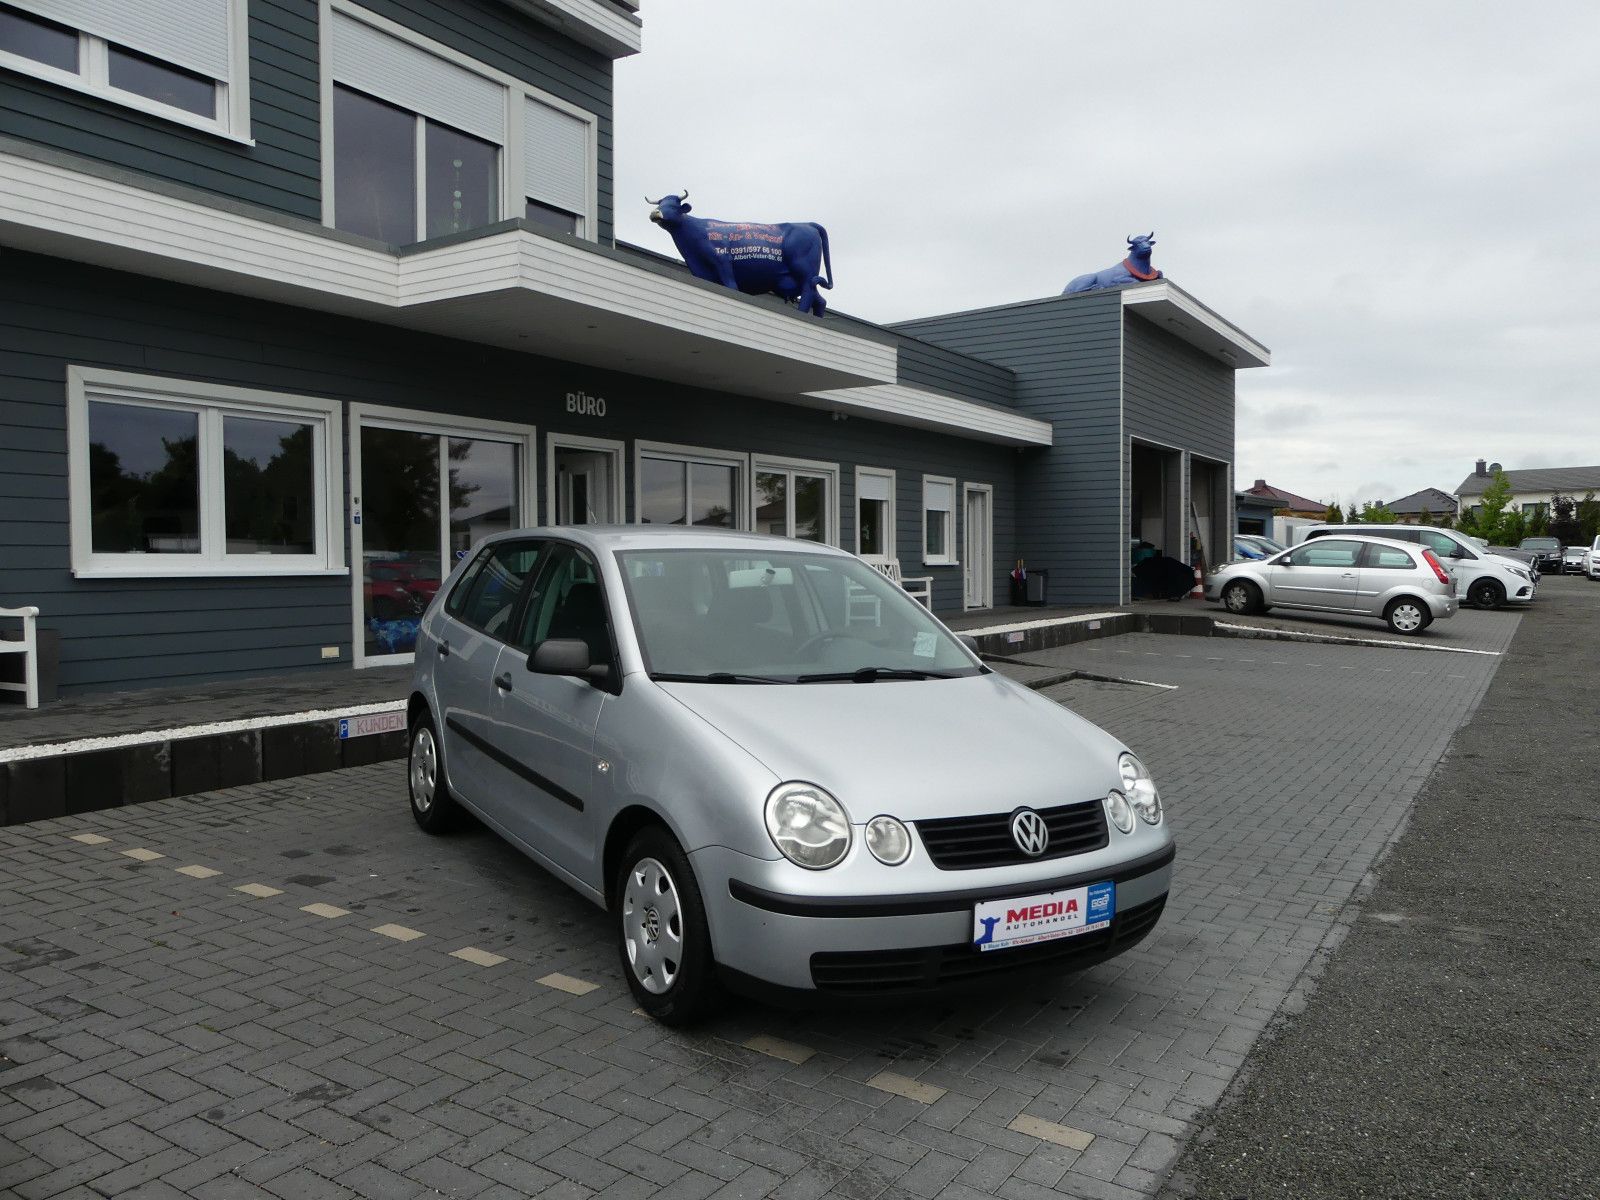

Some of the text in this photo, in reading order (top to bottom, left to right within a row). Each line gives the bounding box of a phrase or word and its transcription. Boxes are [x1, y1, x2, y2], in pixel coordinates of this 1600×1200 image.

[566, 390, 607, 417] BÜRO
[341, 714, 404, 735] P KUNDEN
[1013, 811, 1049, 857] VW
[1006, 914, 1078, 931] AUTOHANDEL
[1007, 899, 1078, 924] MEDIA
